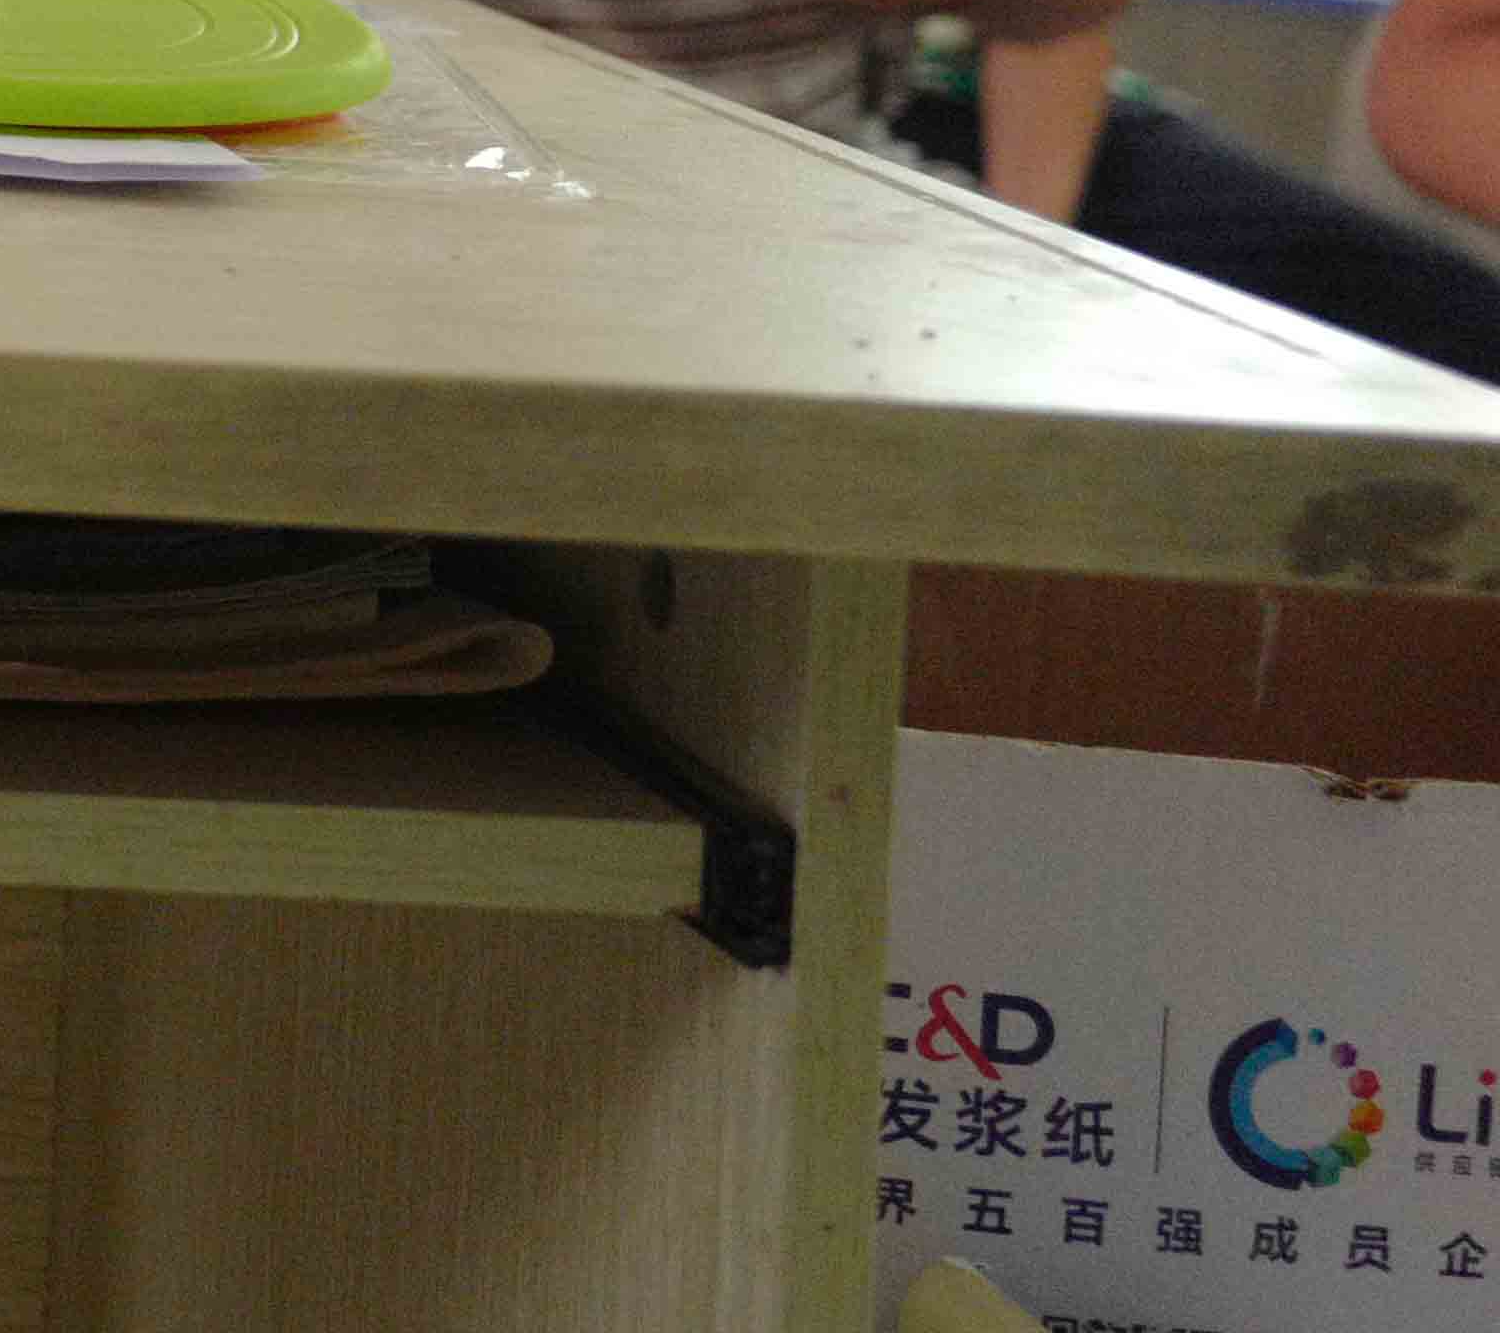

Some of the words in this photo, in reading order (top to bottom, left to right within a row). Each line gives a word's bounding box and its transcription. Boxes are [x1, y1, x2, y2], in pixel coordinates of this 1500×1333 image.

[884, 982, 1057, 1080] &D
[878, 1077, 1117, 1169] 发浆纸
